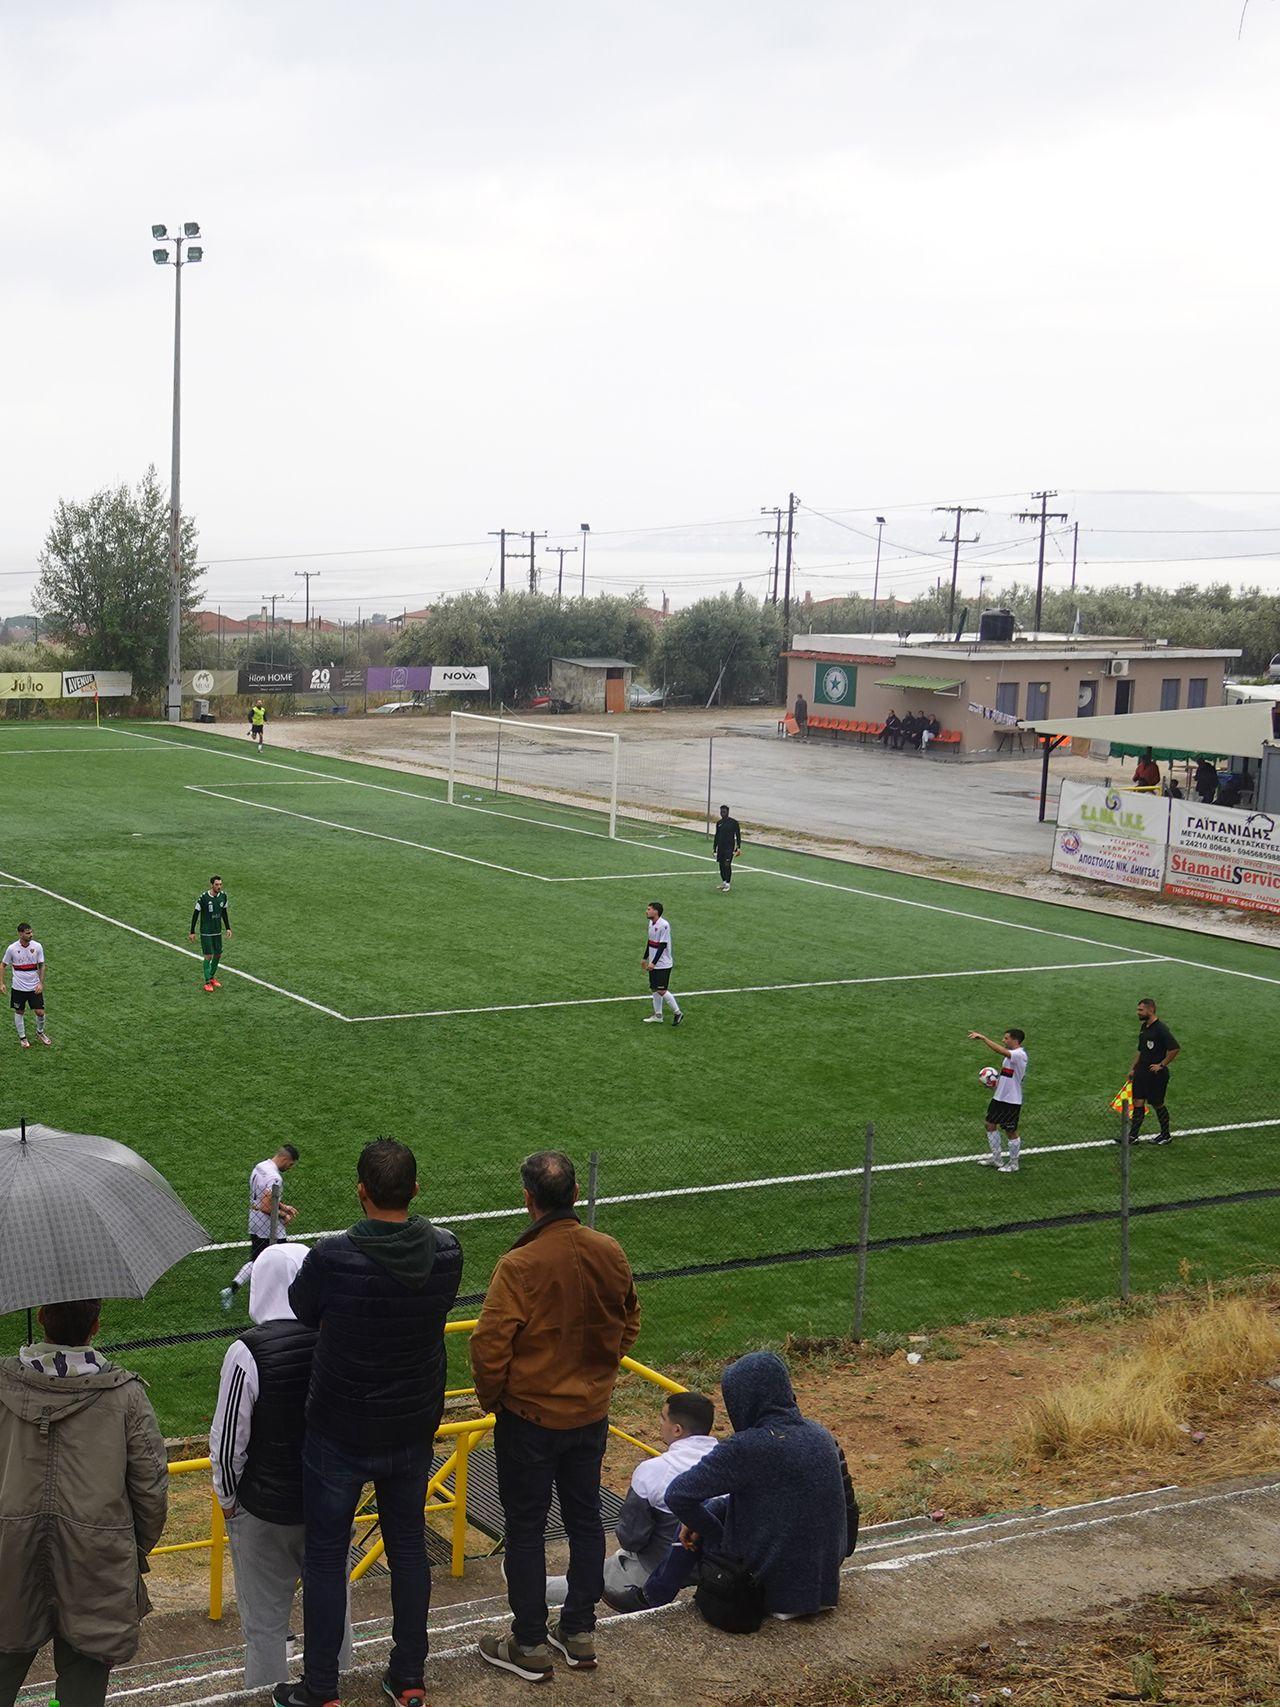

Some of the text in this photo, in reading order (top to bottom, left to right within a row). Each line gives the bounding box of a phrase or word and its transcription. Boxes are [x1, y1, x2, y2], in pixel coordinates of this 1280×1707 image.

[67, 674, 95, 693] AVENUE
[267, 673, 293, 682] HOME
[311, 669, 330, 683] 20
[443, 672, 477, 680] NOVA
[1187, 816, 1272, 841] ΓΑΪΤΑΝΙΔΗΣ
[1181, 830, 1280, 852] ΜΕΤΑΛΛΙΚΕΣ ΚΑΤΑΣΚΕΥΕΣ
[1185, 839, 1207, 849] 24210
[1078, 854, 1115, 870] ΑΠΟΣΤΟΛΟΣ
